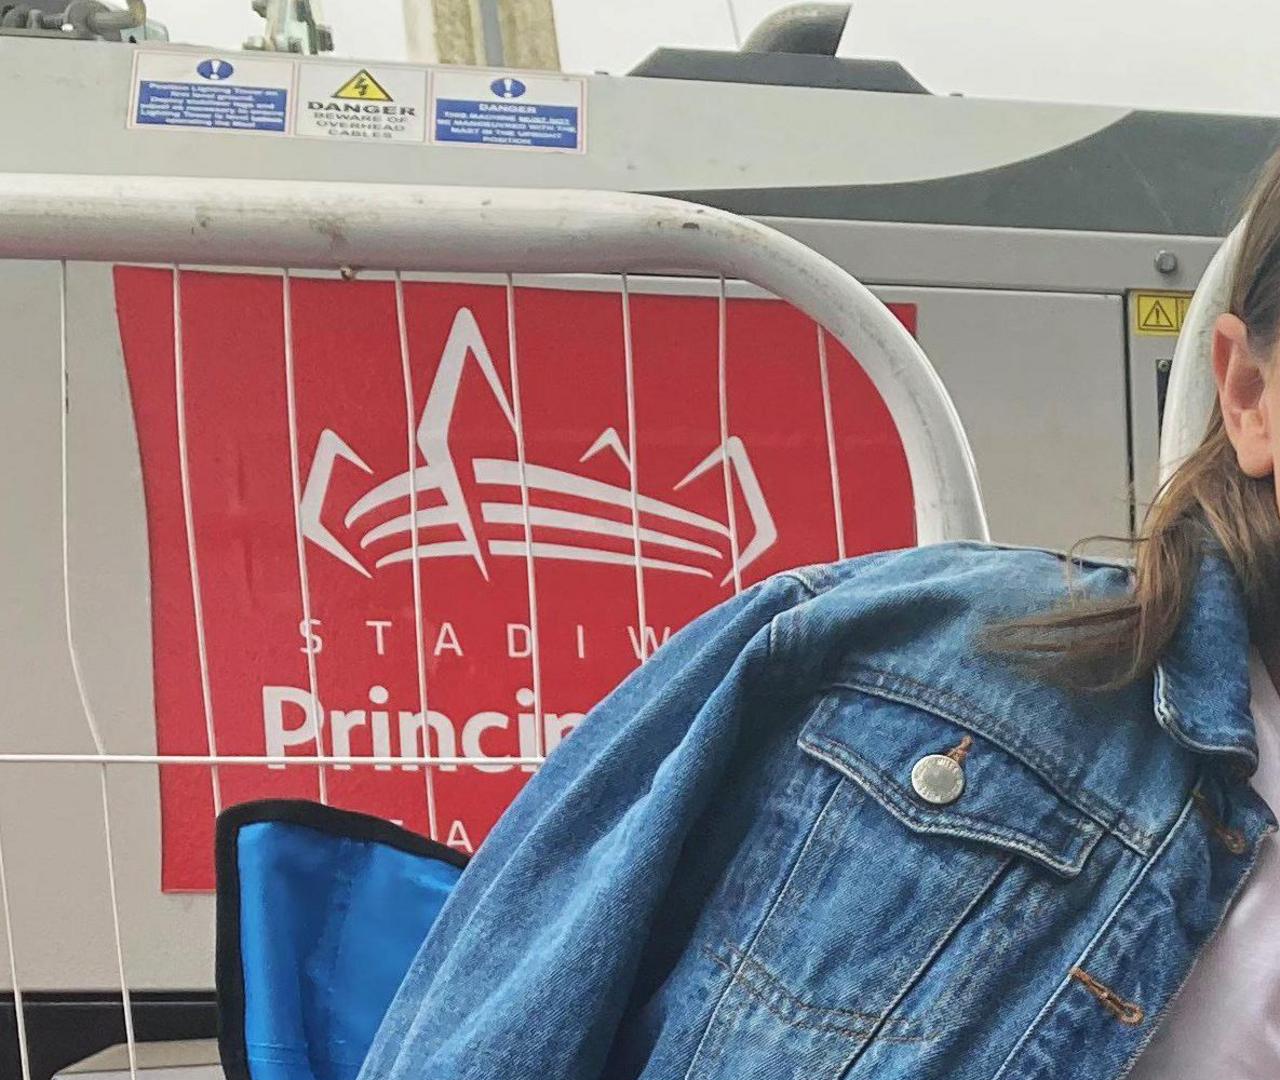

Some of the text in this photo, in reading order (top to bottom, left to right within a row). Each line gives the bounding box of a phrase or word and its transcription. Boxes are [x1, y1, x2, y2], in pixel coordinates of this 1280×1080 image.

[307, 101, 415, 116] DANGER
[478, 103, 537, 114] DANGER
[314, 112, 382, 123] BEWARE
[316, 120, 405, 132] OVERHEAD
[328, 129, 392, 139] CABLES
